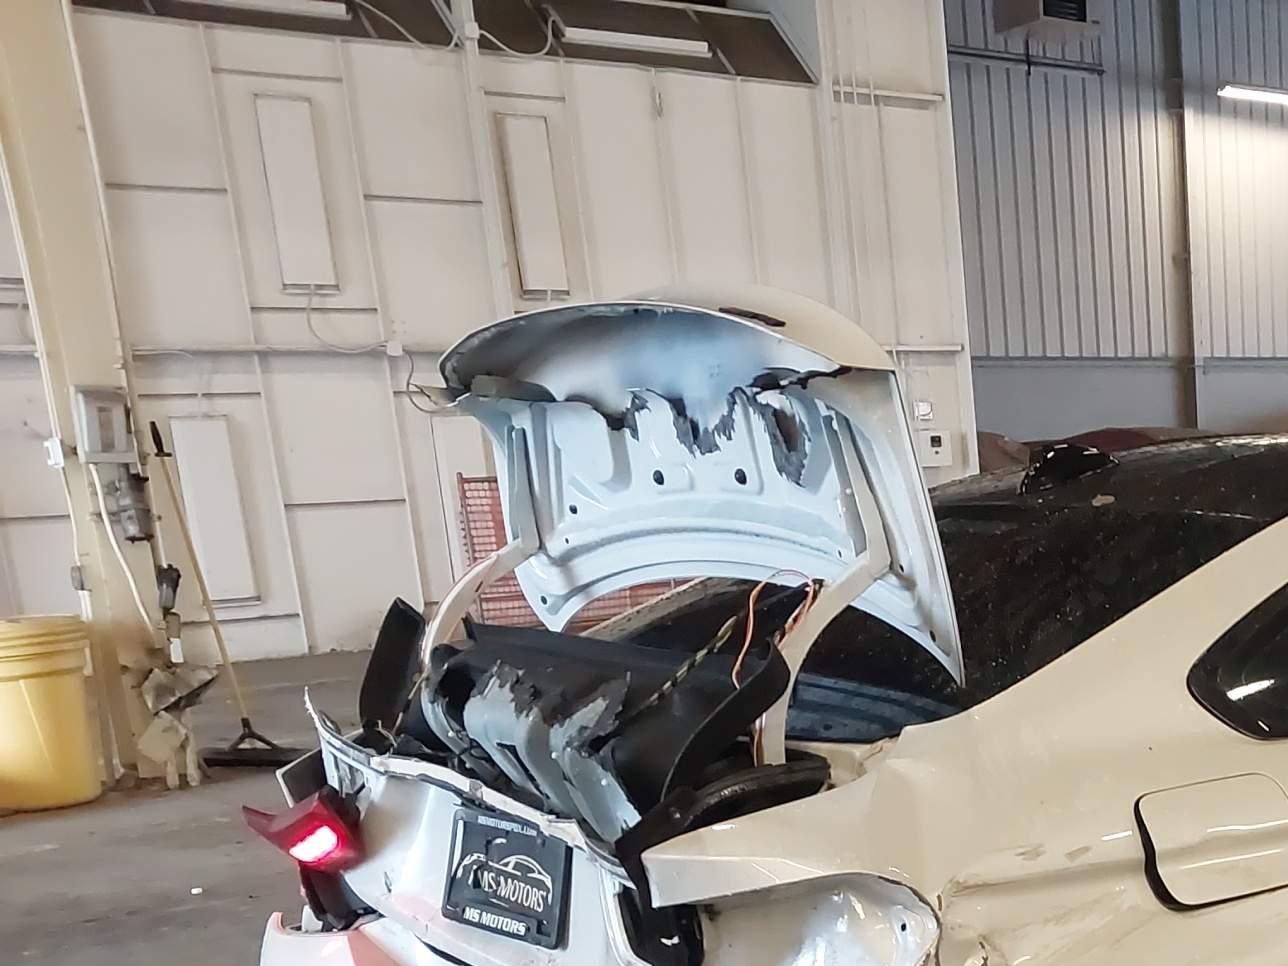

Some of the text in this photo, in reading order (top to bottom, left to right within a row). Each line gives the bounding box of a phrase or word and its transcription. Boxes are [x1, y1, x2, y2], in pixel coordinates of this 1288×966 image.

[496, 875, 547, 912] MOTORS
[463, 906, 527, 936] MS MOTORS
